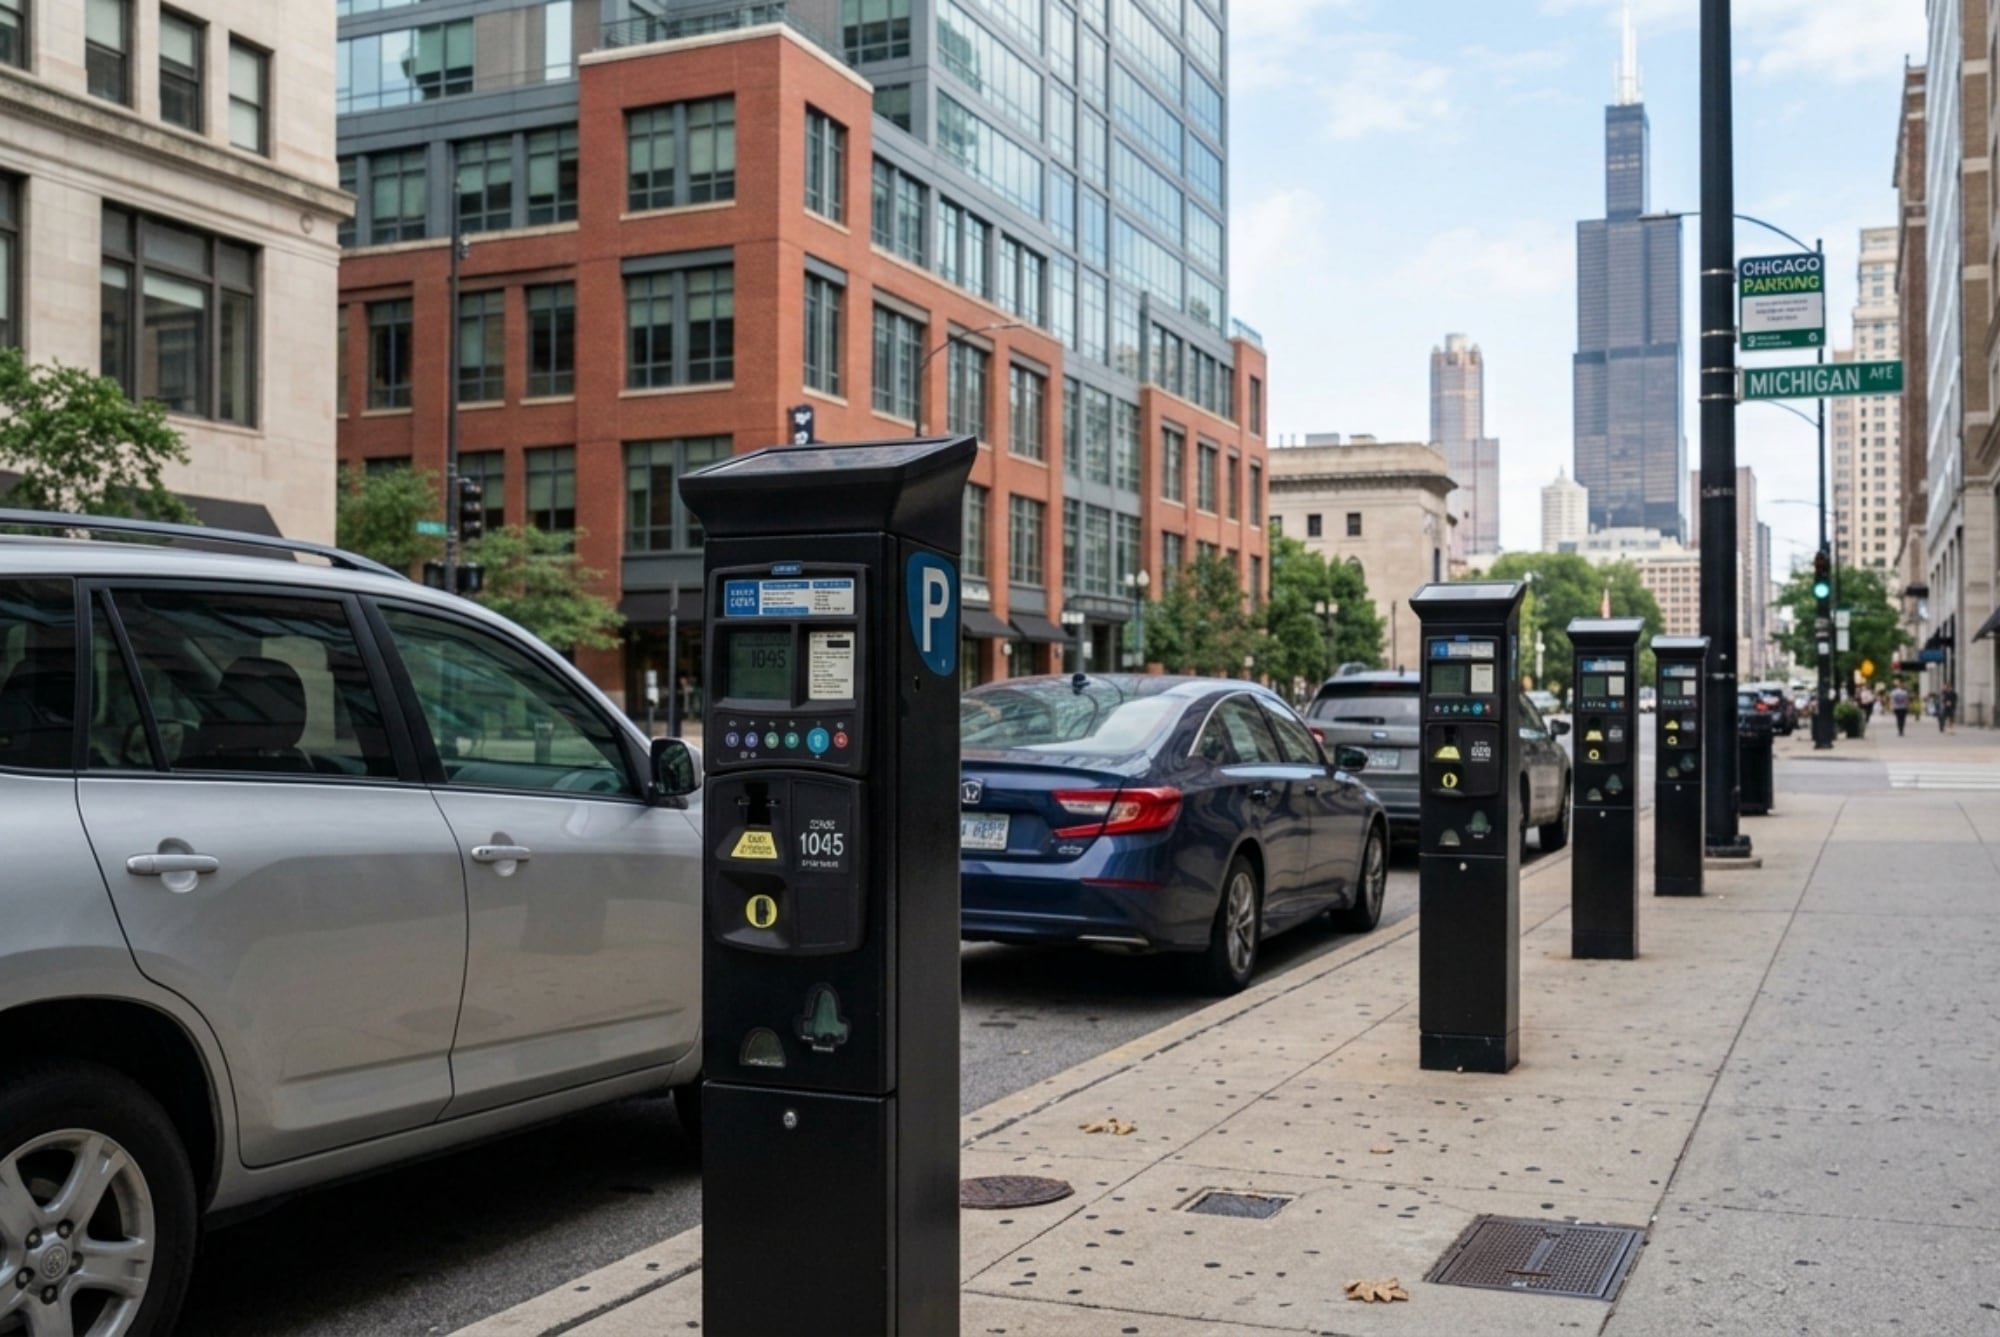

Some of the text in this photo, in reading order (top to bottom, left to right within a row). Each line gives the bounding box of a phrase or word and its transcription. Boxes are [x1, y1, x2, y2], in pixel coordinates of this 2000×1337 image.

[1750, 367, 1860, 396] MICHIGAN
[922, 566, 950, 653] P
[800, 832, 844, 856] 1045
